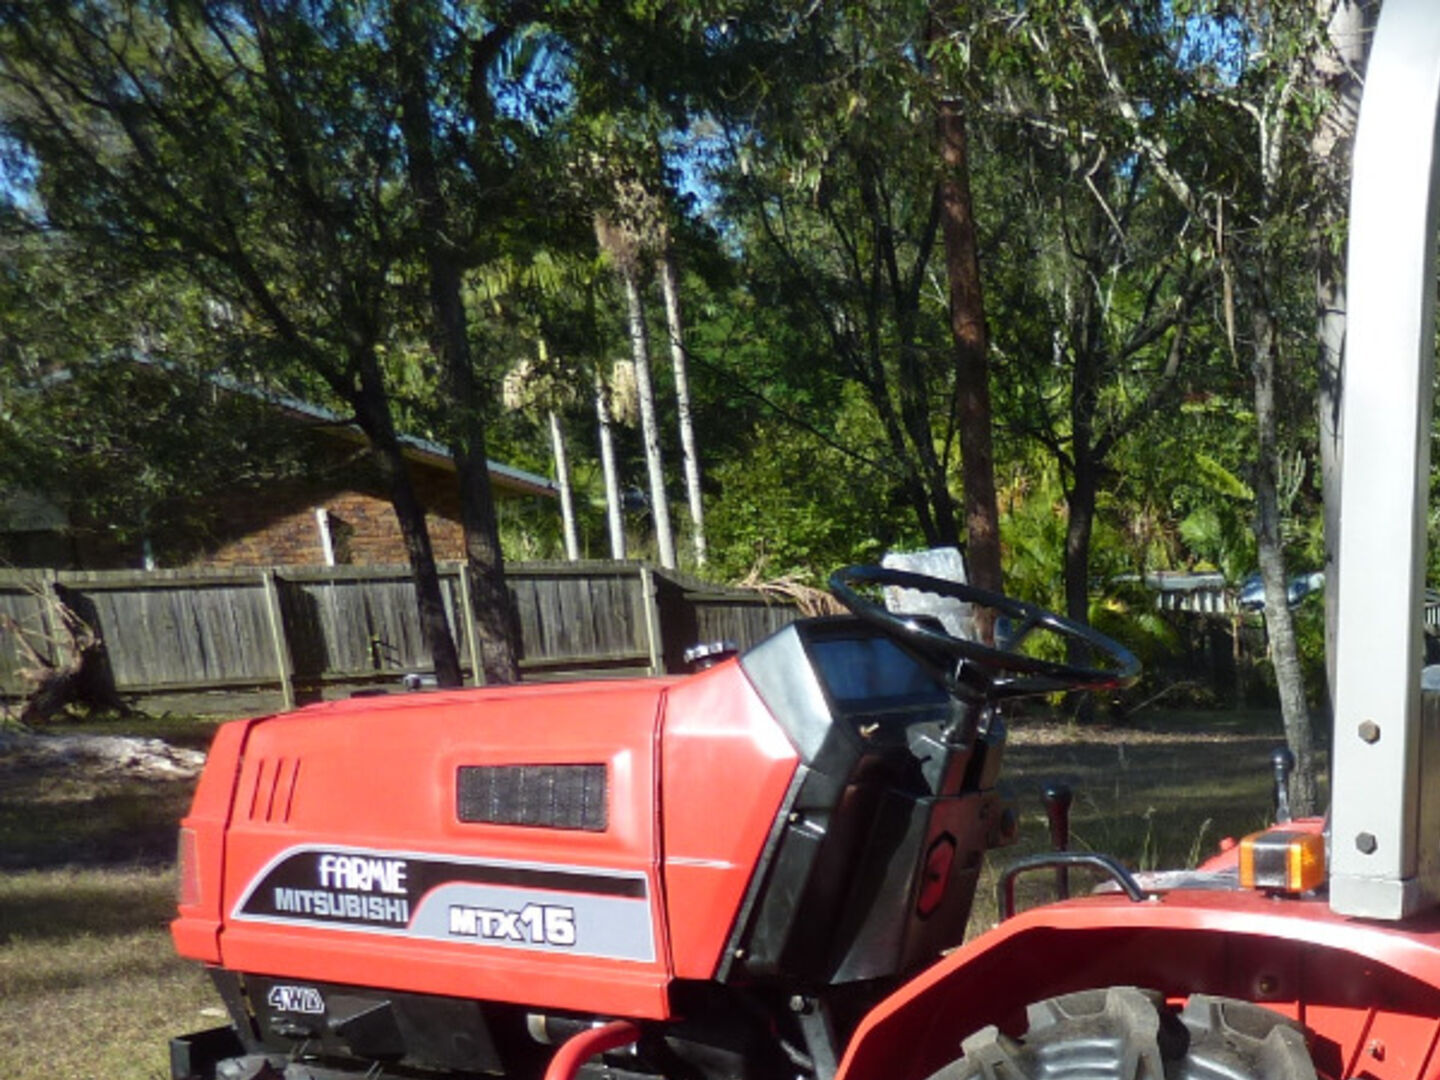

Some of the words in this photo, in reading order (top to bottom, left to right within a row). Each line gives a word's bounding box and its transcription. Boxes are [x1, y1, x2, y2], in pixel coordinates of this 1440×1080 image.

[275, 887, 409, 922] MITSUBISHI
[448, 902, 577, 946] MTX15
[268, 985, 325, 1014] 4WD
